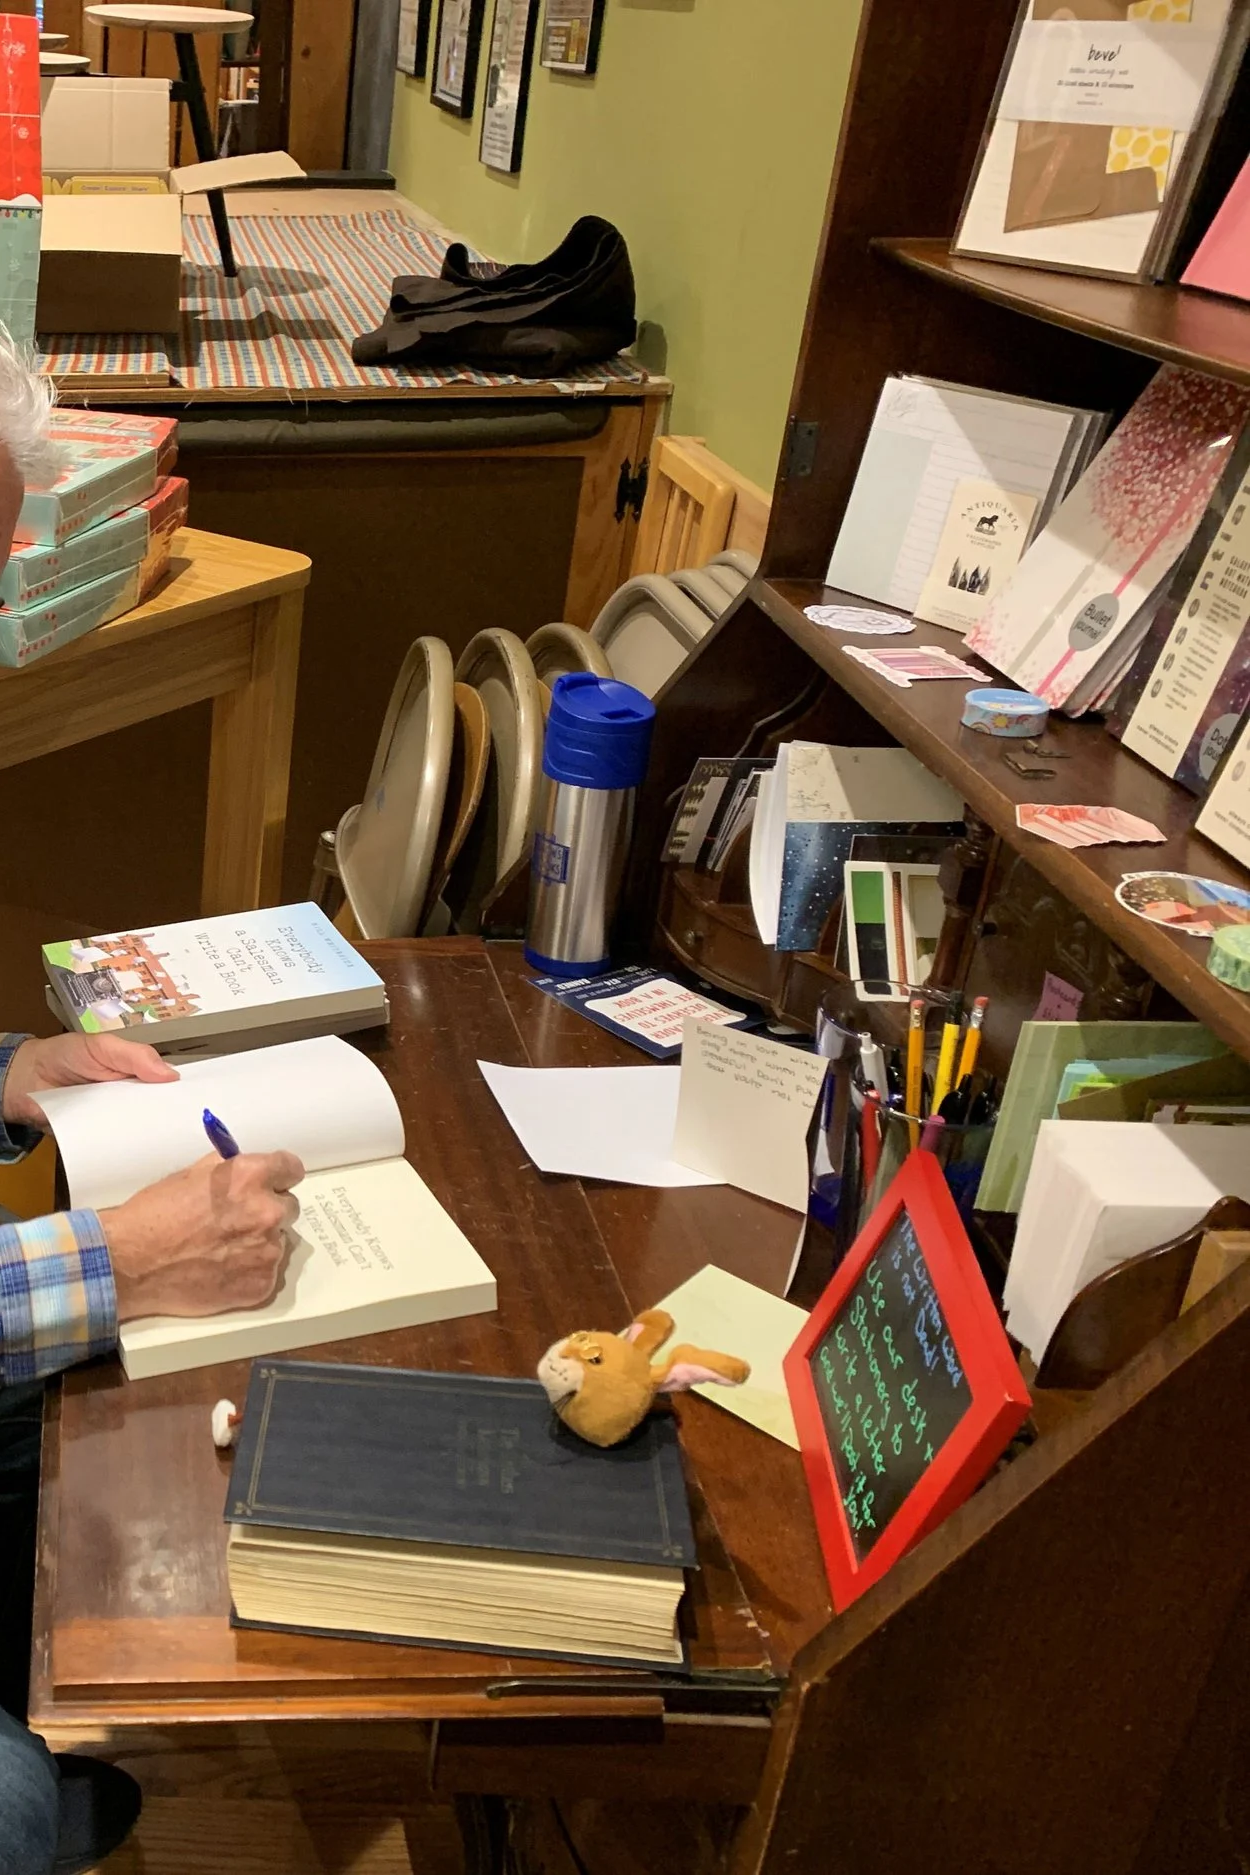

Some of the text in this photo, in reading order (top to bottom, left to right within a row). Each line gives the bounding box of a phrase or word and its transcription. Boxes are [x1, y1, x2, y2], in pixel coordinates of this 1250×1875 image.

[1085, 603, 1112, 628] Bullet
[194, 932, 246, 996] Write a Book
[226, 947, 254, 973] Can't
[235, 929, 283, 986] a Salesman
[265, 938, 296, 968] Knows
[277, 926, 325, 974] Everybody
[614, 996, 642, 1010] BOOK
[651, 988, 667, 997] IN
[612, 999, 678, 1023] THEMSELVES
[637, 1003, 709, 1030] DESERVES TO
[302, 1205, 324, 1233] Write
[323, 1241, 348, 1267] Book
[319, 1201, 353, 1244] Salesman
[348, 1244, 373, 1271] Can't
[331, 1186, 395, 1271] Everybody Knows
[902, 1272, 916, 1305] not
[866, 1260, 886, 1317] Use
[882, 1325, 904, 1371] our
[901, 1378, 927, 1445] desk
[854, 1393, 863, 1413] a
[859, 1404, 887, 1476] letter
[890, 1422, 904, 1456] to
